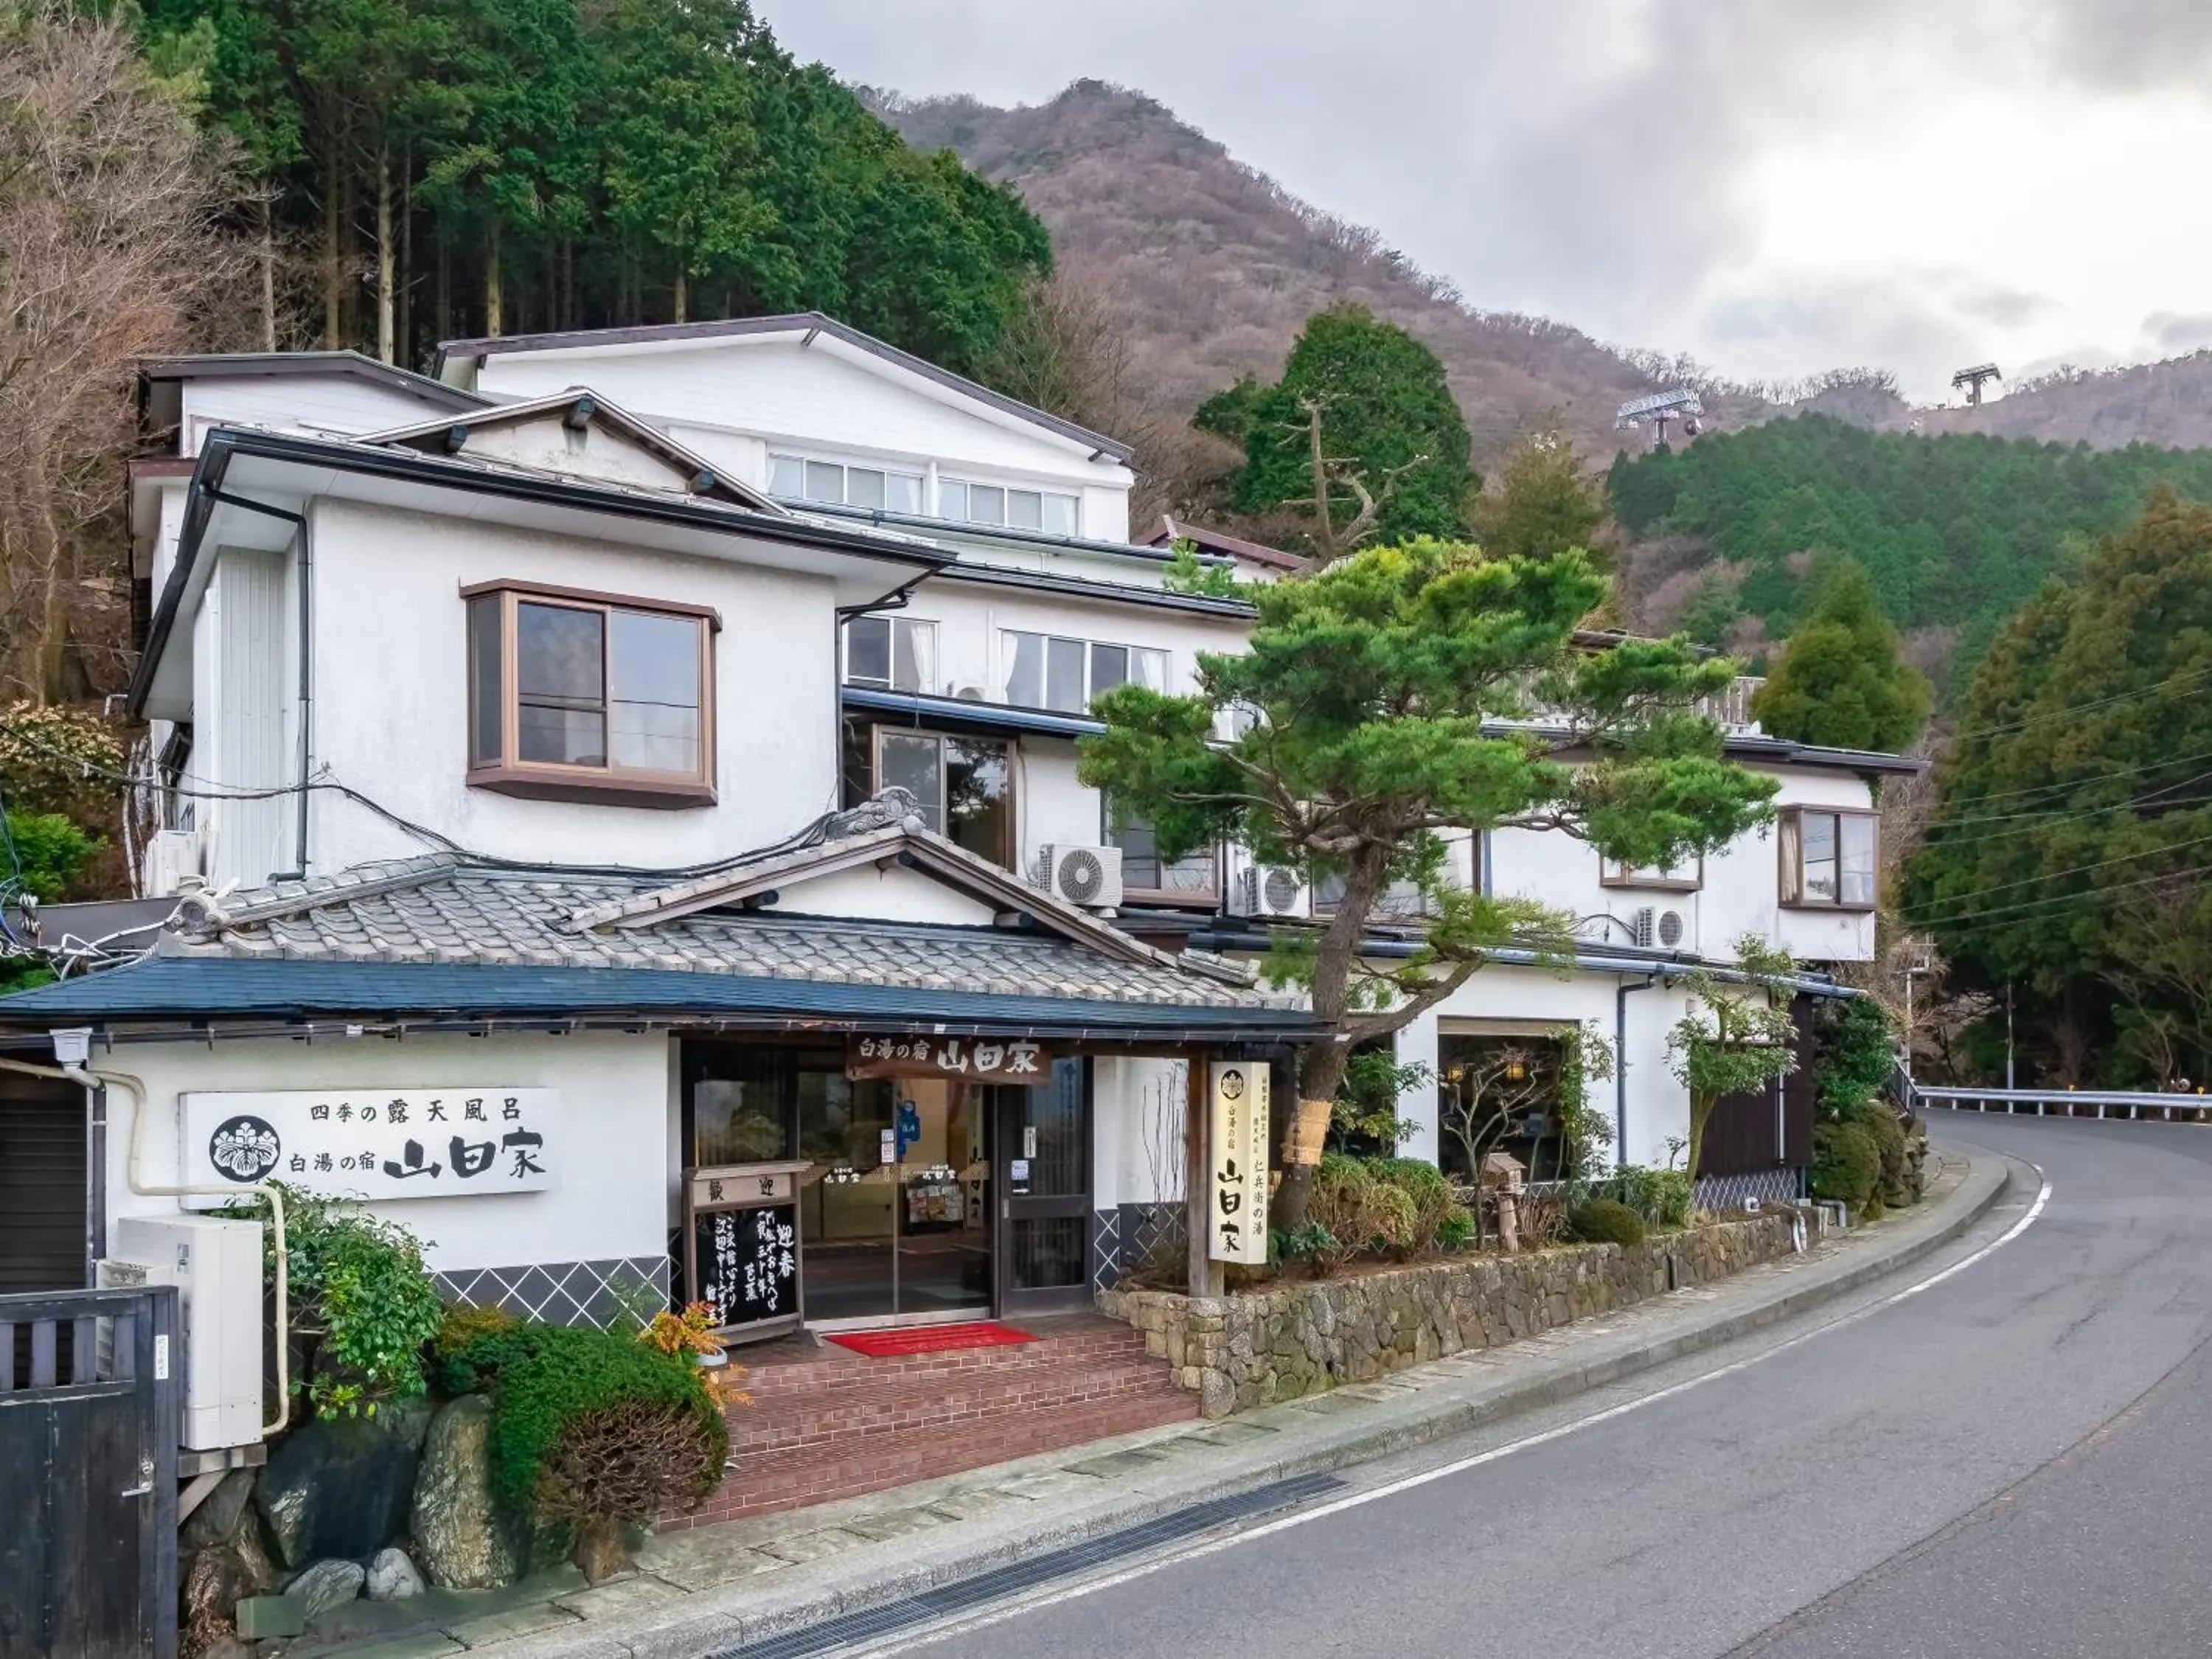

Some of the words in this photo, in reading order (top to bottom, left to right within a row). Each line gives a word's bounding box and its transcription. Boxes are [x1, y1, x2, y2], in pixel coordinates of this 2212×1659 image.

[859, 1037, 931, 1061] 白湯の宿
[937, 1038, 1041, 1074] 山田家
[310, 1097, 522, 1124] 四季の露天風呂
[289, 1150, 376, 1173] 白湯の宿
[383, 1126, 547, 1180] 山田家
[1217, 1158, 1244, 1253] 山田家
